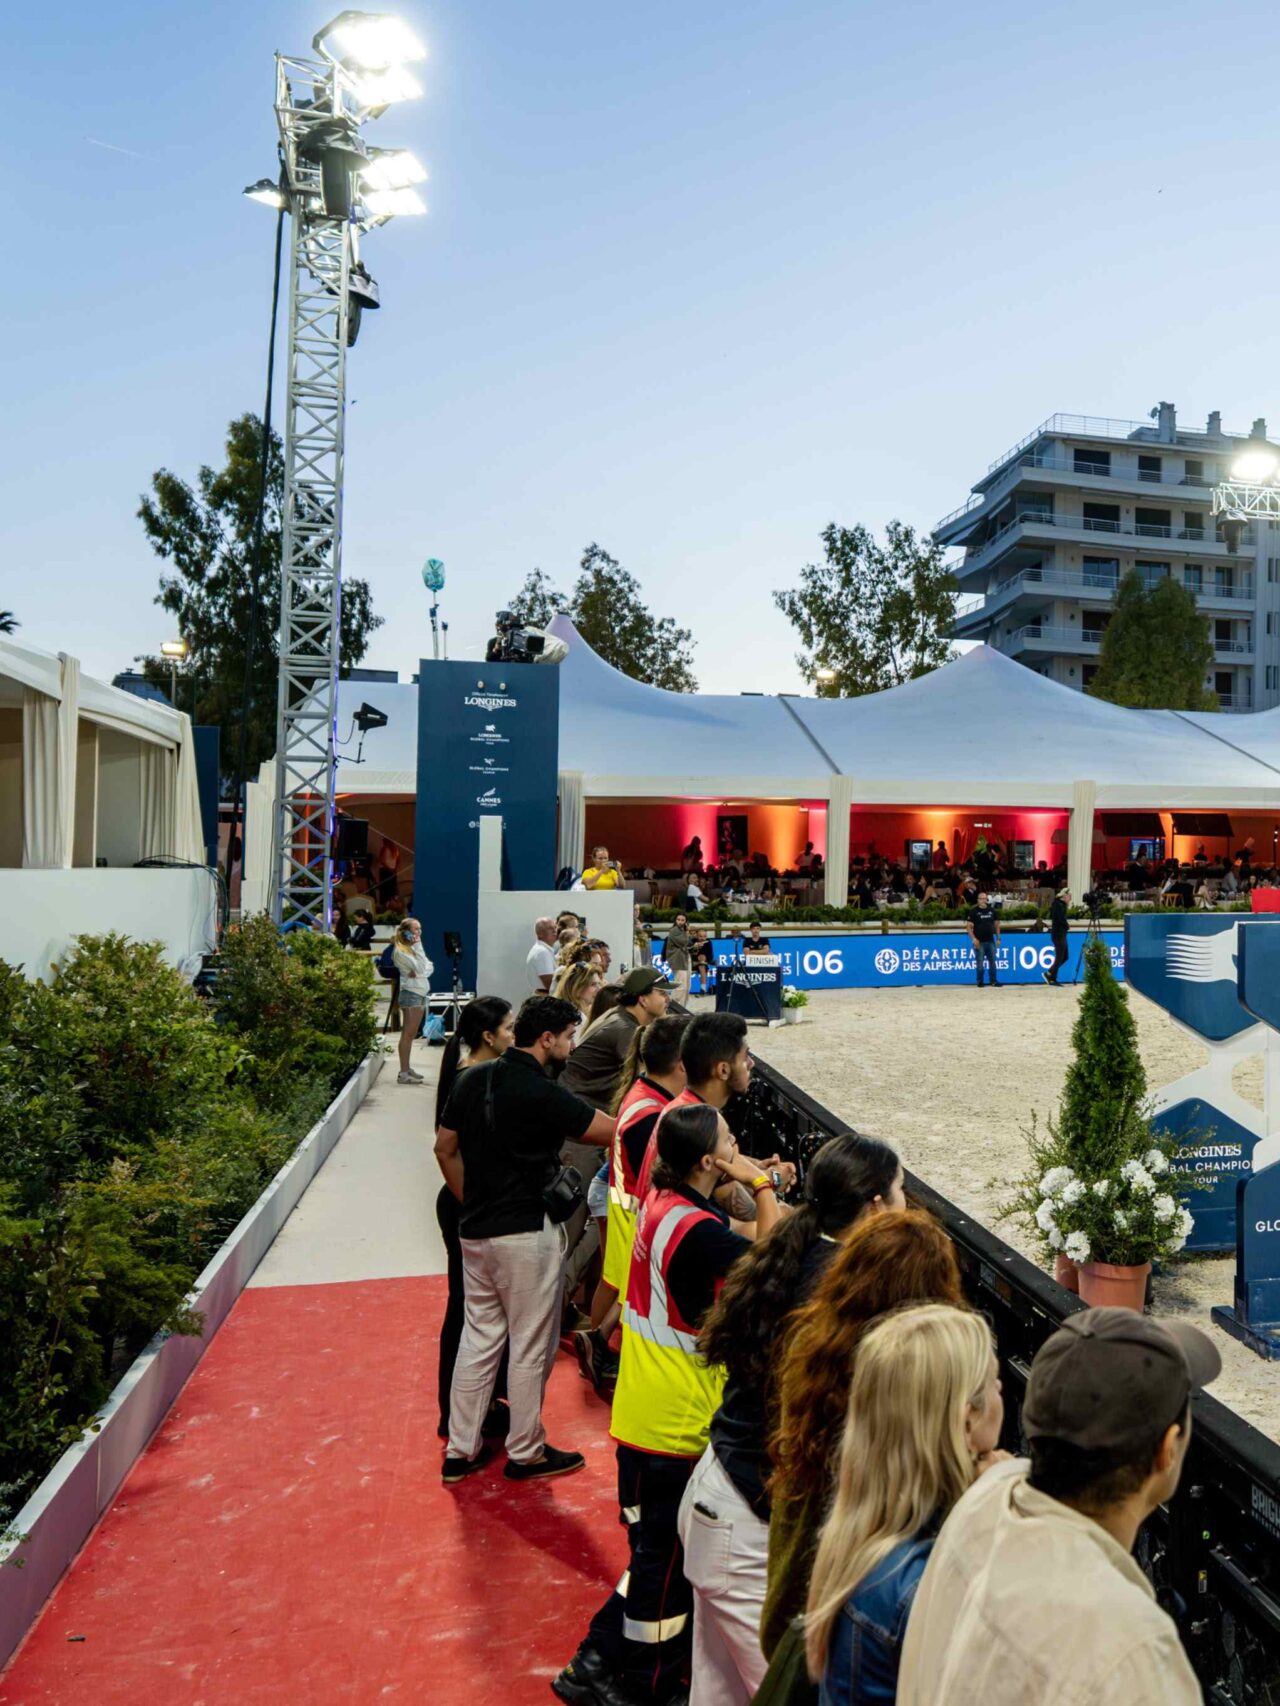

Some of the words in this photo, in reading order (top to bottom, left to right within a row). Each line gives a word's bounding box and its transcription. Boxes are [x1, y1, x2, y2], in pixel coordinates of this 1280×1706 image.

[464, 697, 517, 707] LONGINES
[749, 956, 774, 965] FINISH
[803, 949, 843, 975] 06
[1019, 946, 1056, 969] 06
[903, 962, 921, 972] DES
